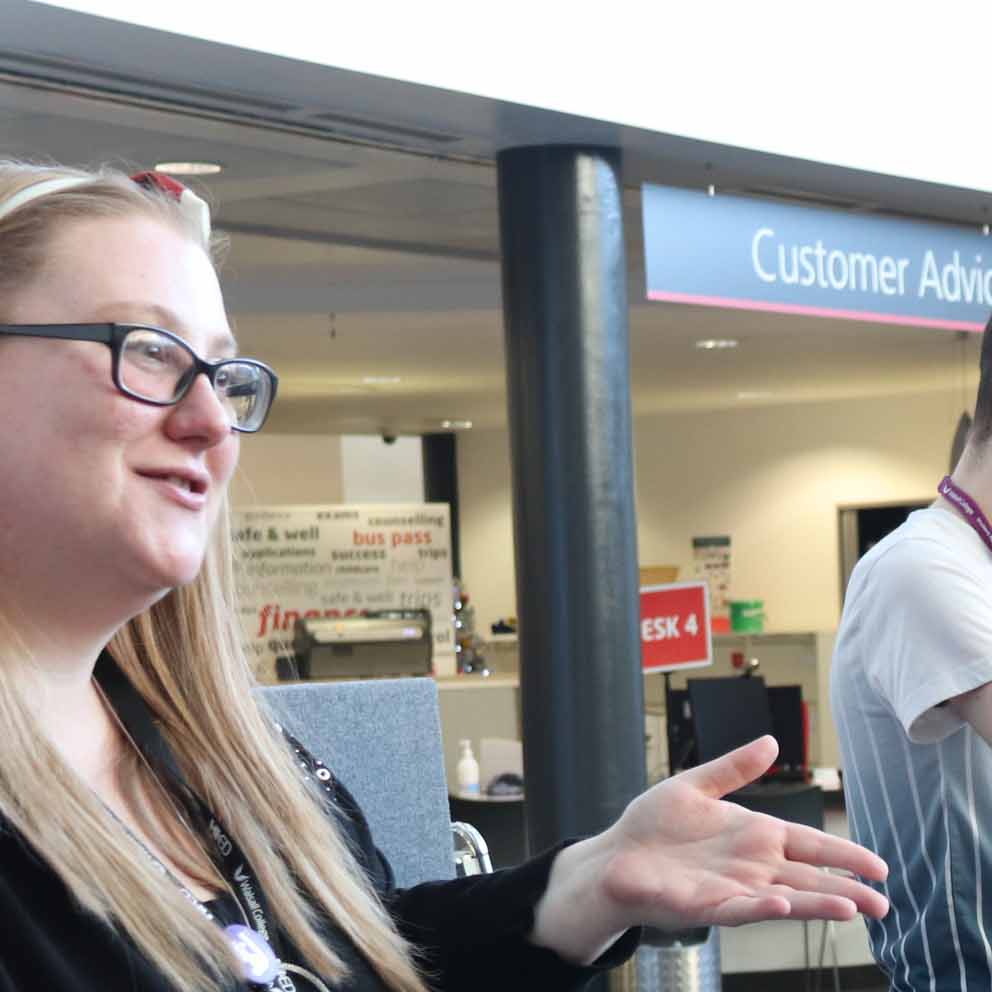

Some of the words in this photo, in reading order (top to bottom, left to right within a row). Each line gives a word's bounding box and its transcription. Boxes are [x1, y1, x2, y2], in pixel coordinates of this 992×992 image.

[751, 228, 910, 297] Customer
[267, 527, 279, 542] &
[284, 526, 319, 541] well
[352, 529, 385, 545] bus
[391, 530, 432, 548] pass
[331, 549, 385, 561] success
[418, 548, 448, 561] trips
[641, 615, 680, 642] ESK
[684, 612, 699, 636] 4
